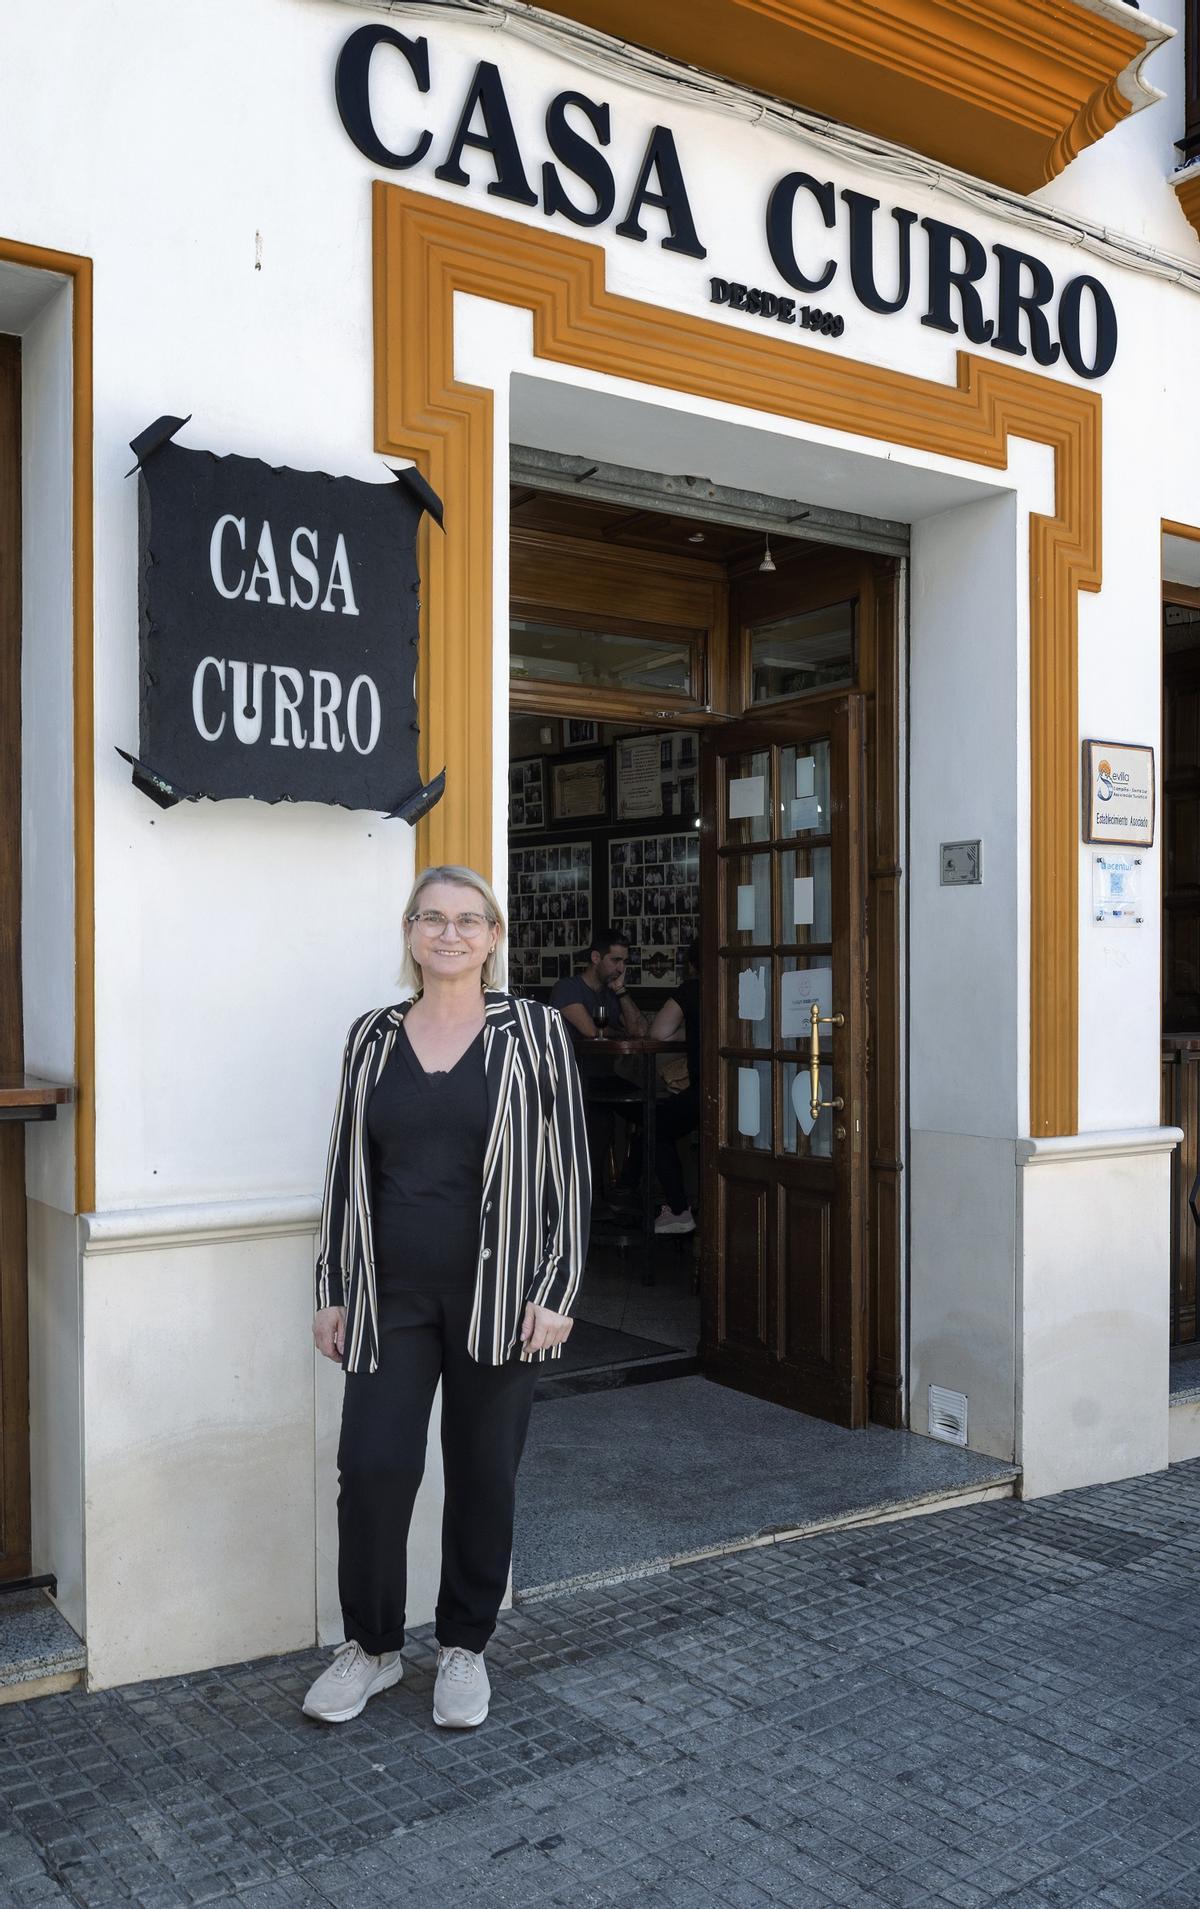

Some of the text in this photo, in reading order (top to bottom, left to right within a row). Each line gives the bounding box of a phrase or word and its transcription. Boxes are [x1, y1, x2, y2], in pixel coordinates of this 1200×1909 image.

[335, 23, 1118, 380] CASA CURRO
[709, 277, 845, 338] DESDE 1989
[209, 514, 360, 616] CASA
[192, 656, 381, 755] CURRO
[1096, 812, 1149, 828] Establecimiento Asociado
